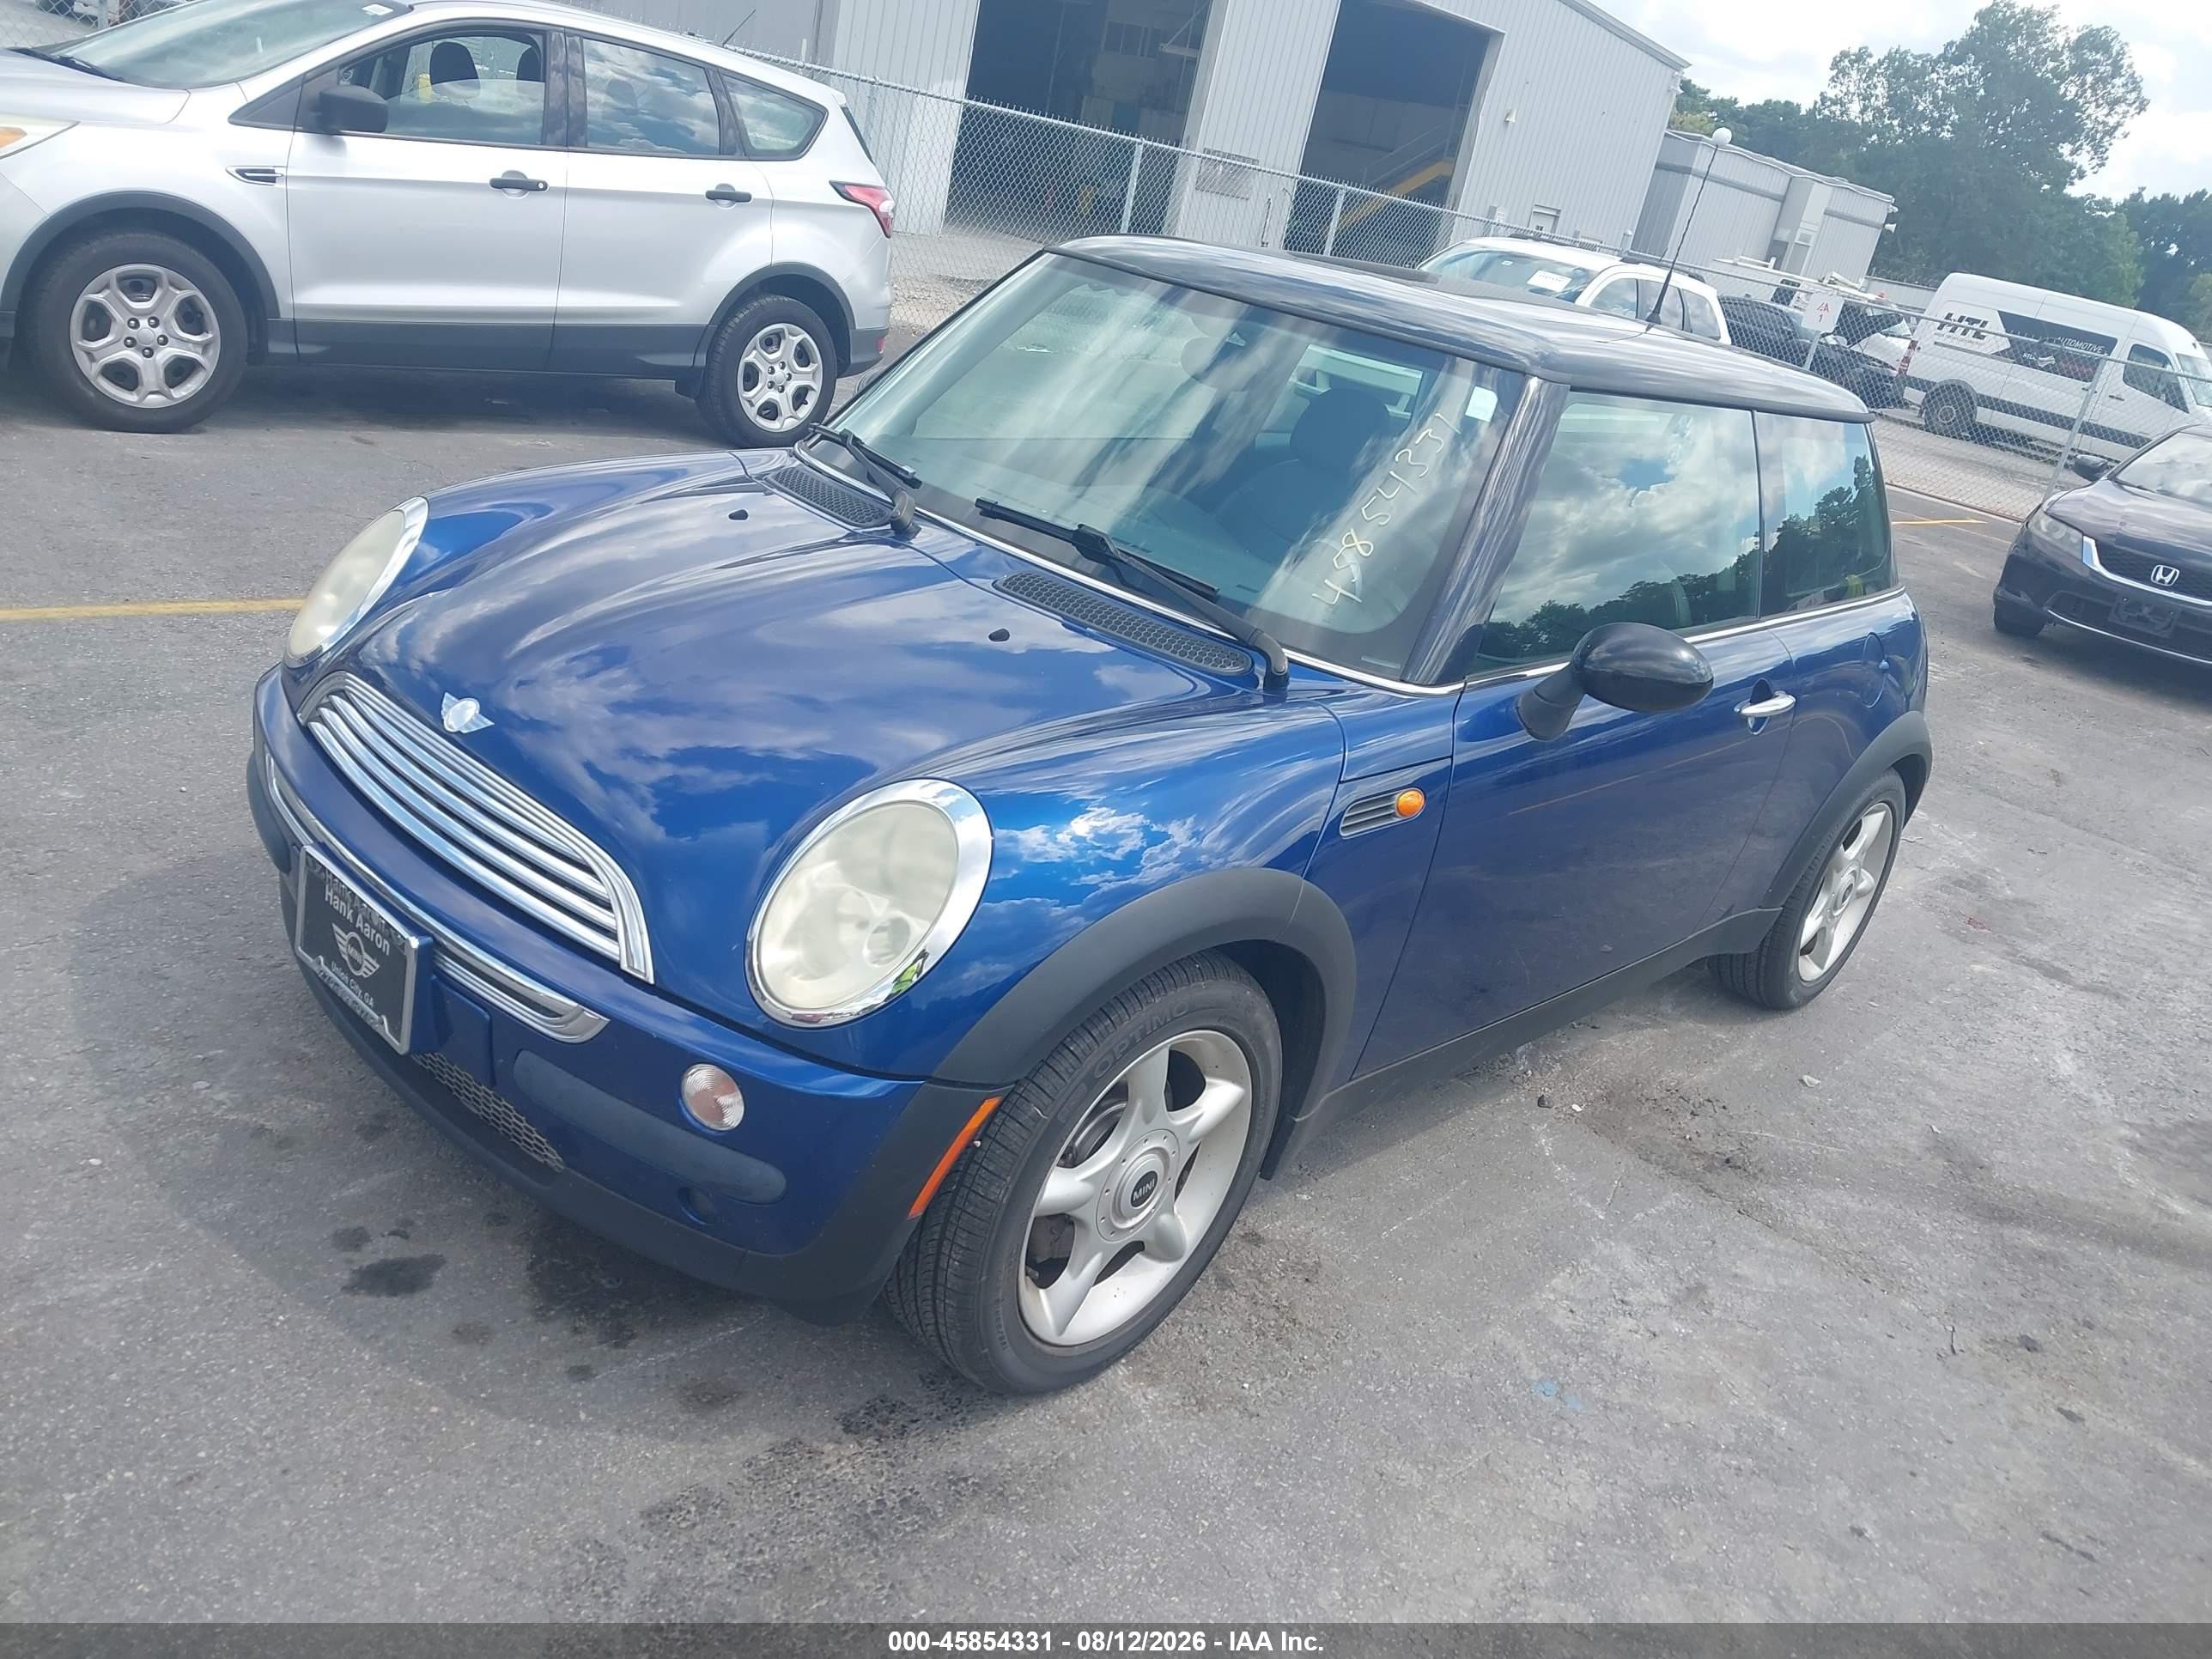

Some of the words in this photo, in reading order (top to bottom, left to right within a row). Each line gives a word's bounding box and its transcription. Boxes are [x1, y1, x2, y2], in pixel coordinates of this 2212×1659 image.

[325, 883, 353, 923] Hank
[355, 913, 391, 956] Aaron
[364, 992, 374, 1007] GA
[1133, 1178, 1155, 1201] MINI
